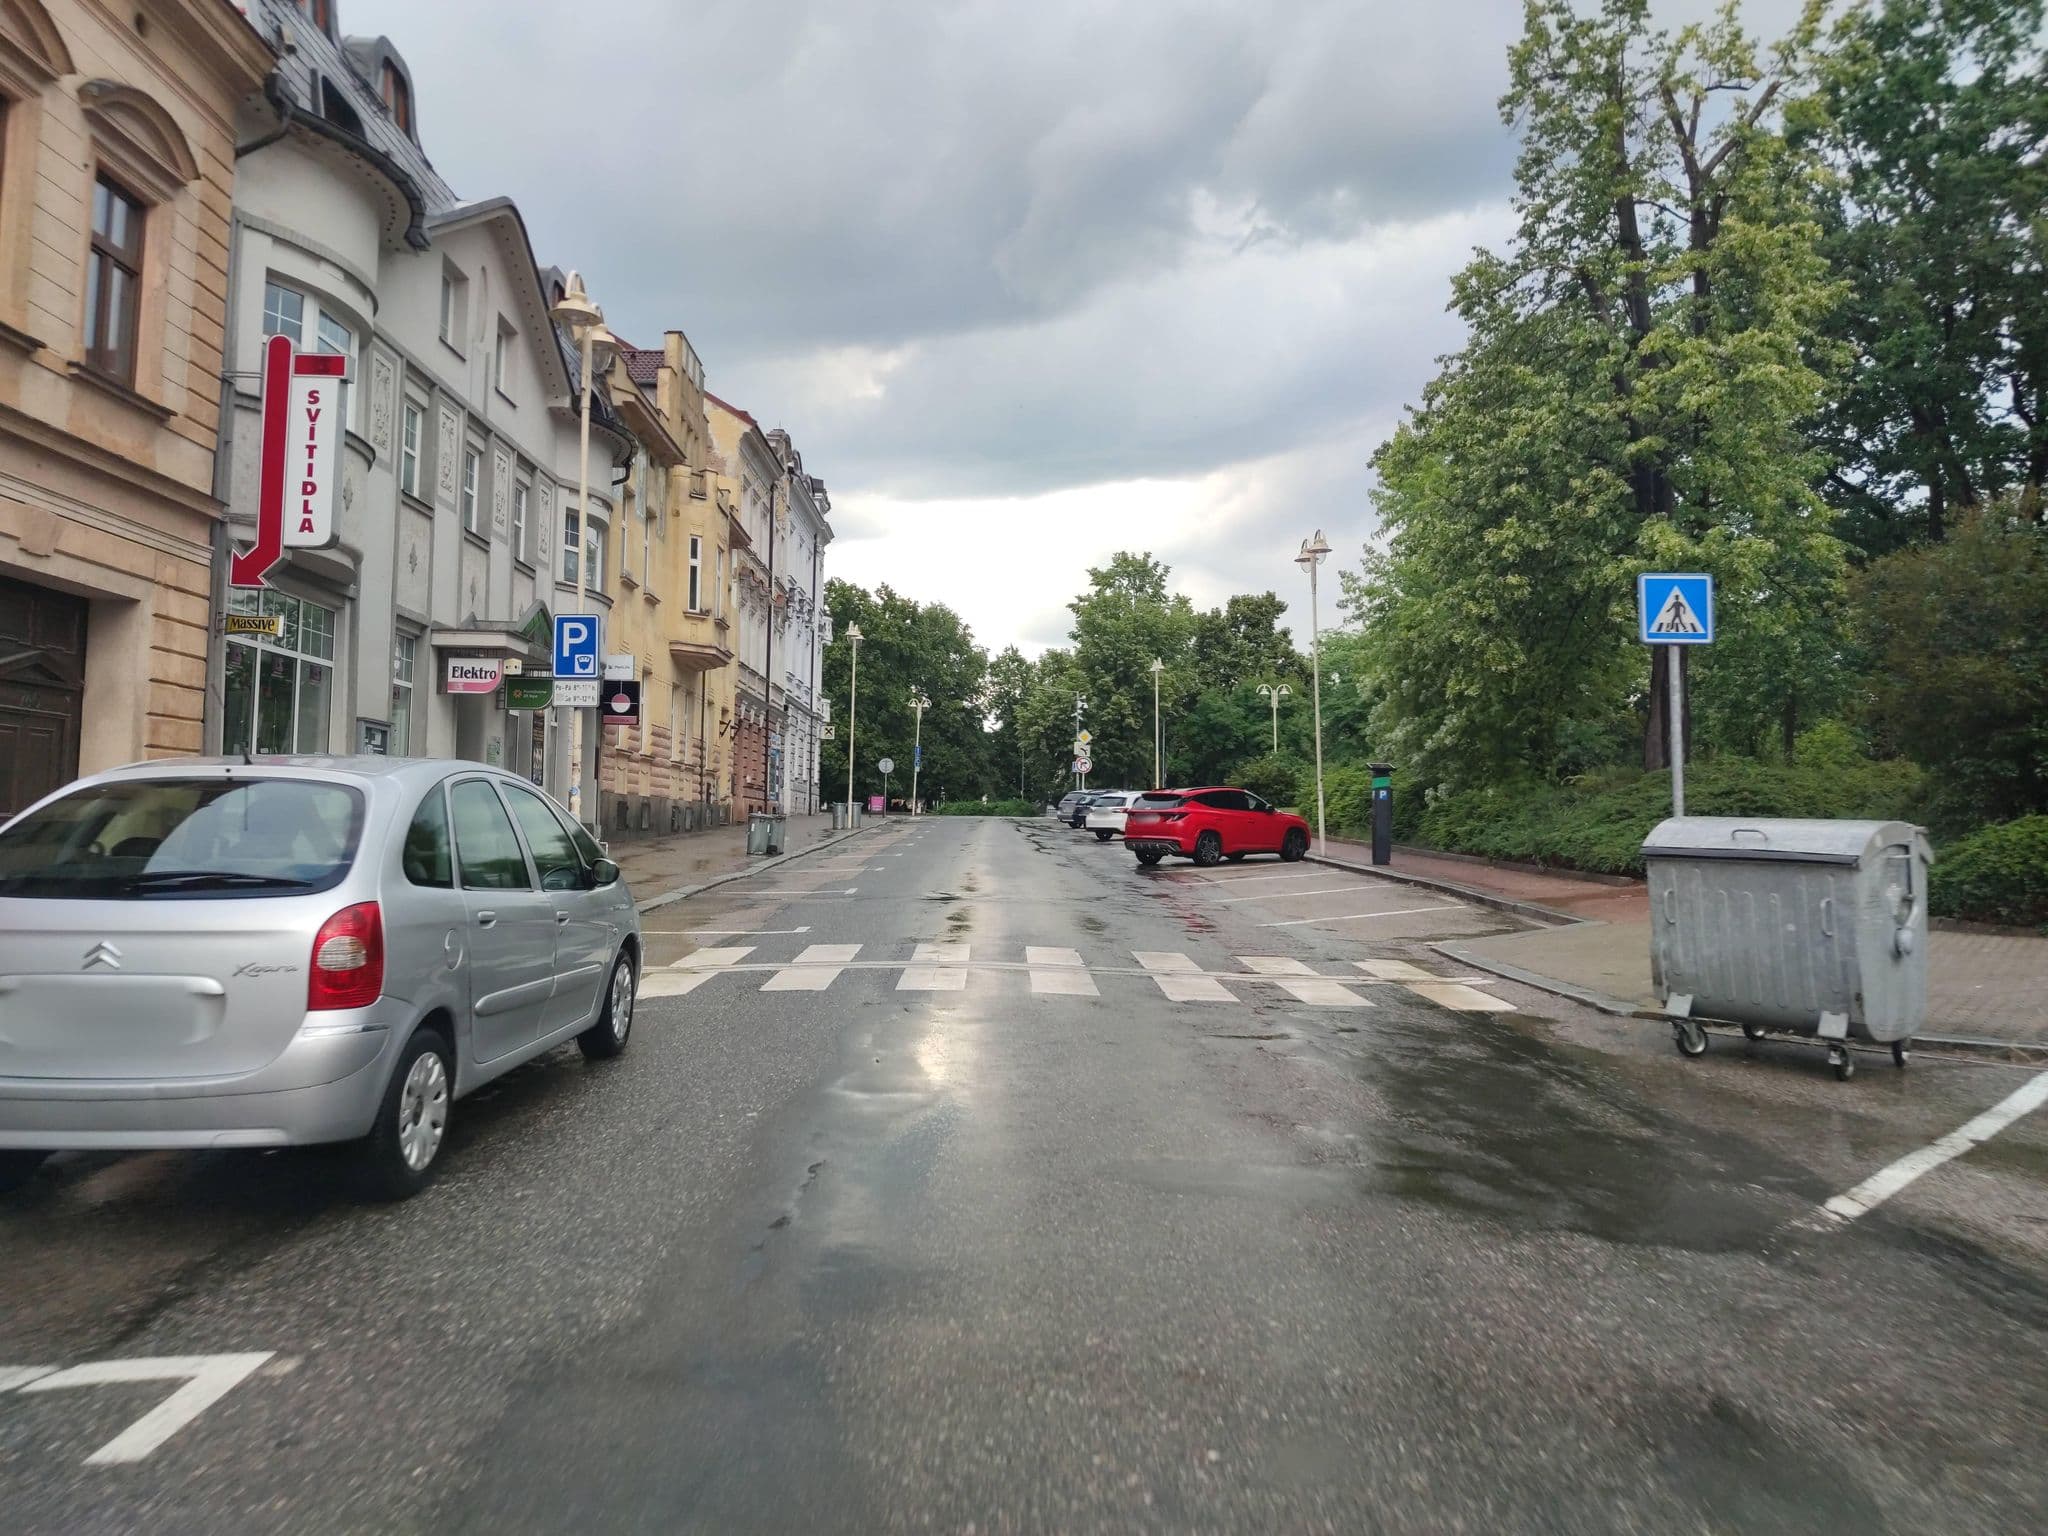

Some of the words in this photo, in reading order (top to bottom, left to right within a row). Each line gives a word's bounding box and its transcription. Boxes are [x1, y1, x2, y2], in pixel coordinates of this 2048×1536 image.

[230, 617, 275, 632] Massive
[562, 622, 588, 657] P
[451, 665, 497, 680] Elektro
